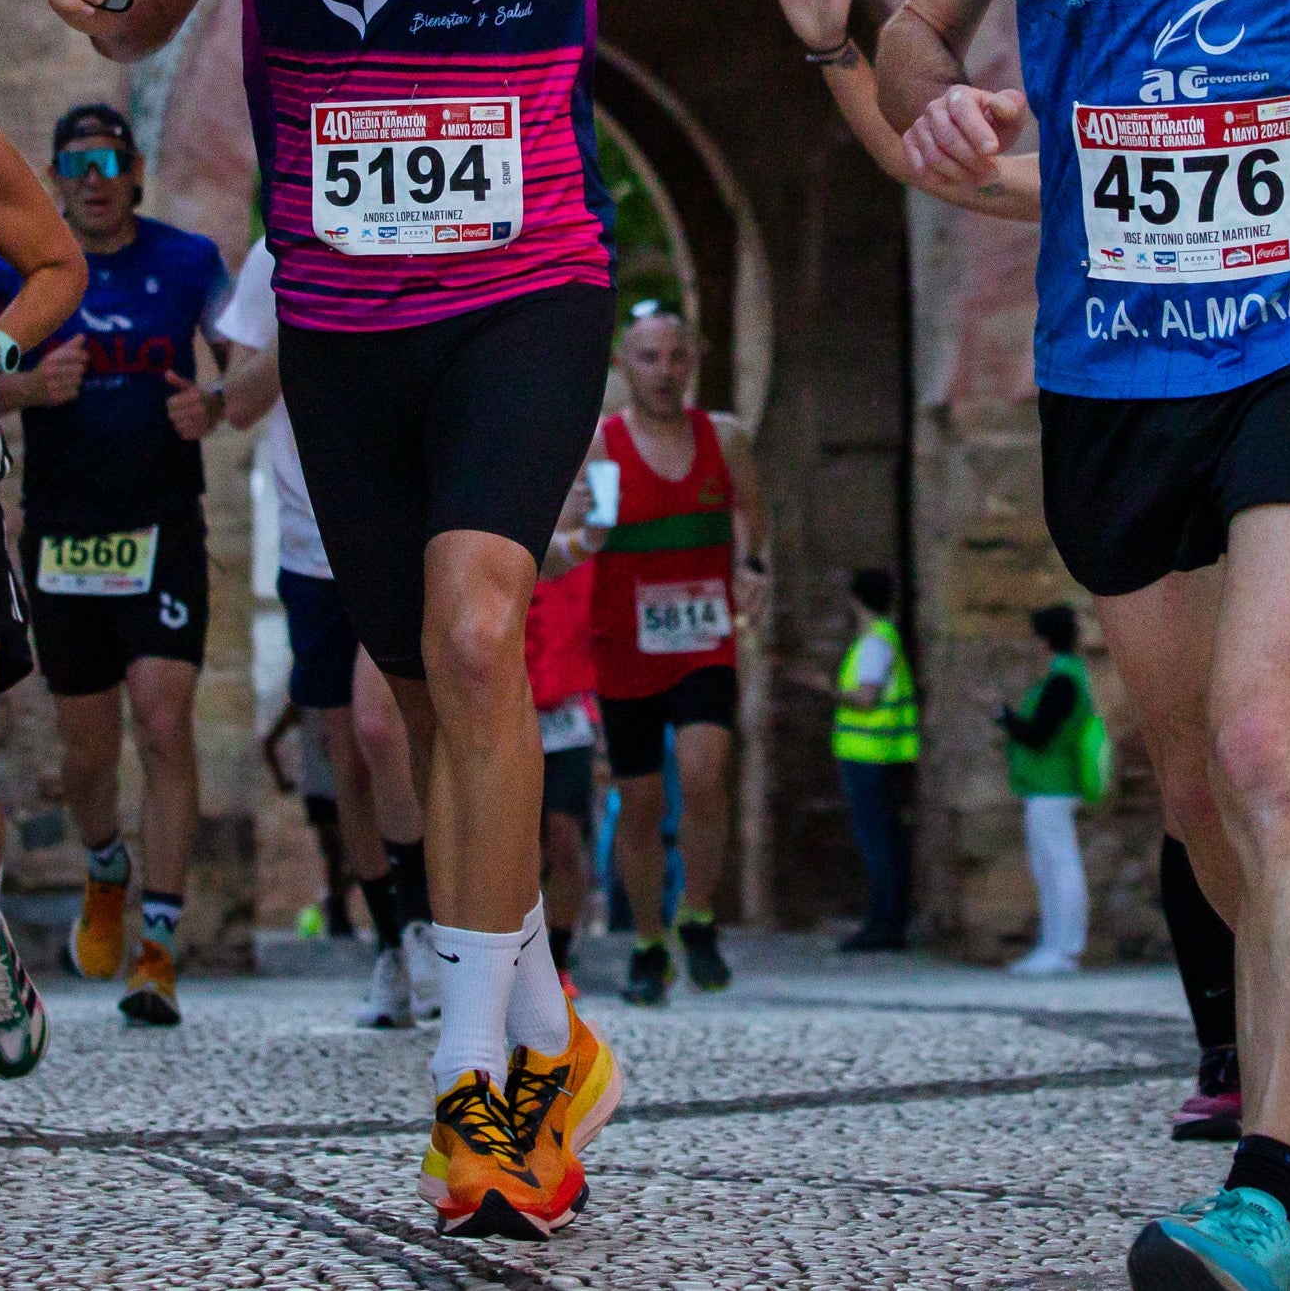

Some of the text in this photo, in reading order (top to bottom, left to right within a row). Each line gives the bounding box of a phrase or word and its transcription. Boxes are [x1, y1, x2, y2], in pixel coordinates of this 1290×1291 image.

[409, 1, 533, 34] Bienestar y Salud
[1195, 71, 1270, 89] prevención
[351, 109, 397, 118] TotalEnergies
[352, 112, 427, 130] MEDIA MARATÓN
[1115, 112, 1169, 121] TotalEnergies
[322, 111, 352, 141] 40
[352, 127, 426, 140] CIUDAD DE GRANADA
[440, 123, 493, 137] 4 MAYO 2024
[1086, 112, 1119, 146] 40
[1116, 115, 1205, 135] MEDIA MARATÓN
[1223, 121, 1286, 143] 4 MAYO 2024
[1119, 133, 1206, 148] CIUDAD DE GRANADA
[324, 144, 491, 207] 5194
[502, 160, 512, 185] SENIOR
[1093, 148, 1285, 226] 4576
[363, 209, 463, 223] ANDRES LOPEZ MARTINEZ
[1124, 224, 1271, 246] JOSE ANTONIO GOMEZ MARTINEZ
[1085, 296, 1149, 341] C.A.
[47, 535, 138, 569] 1560
